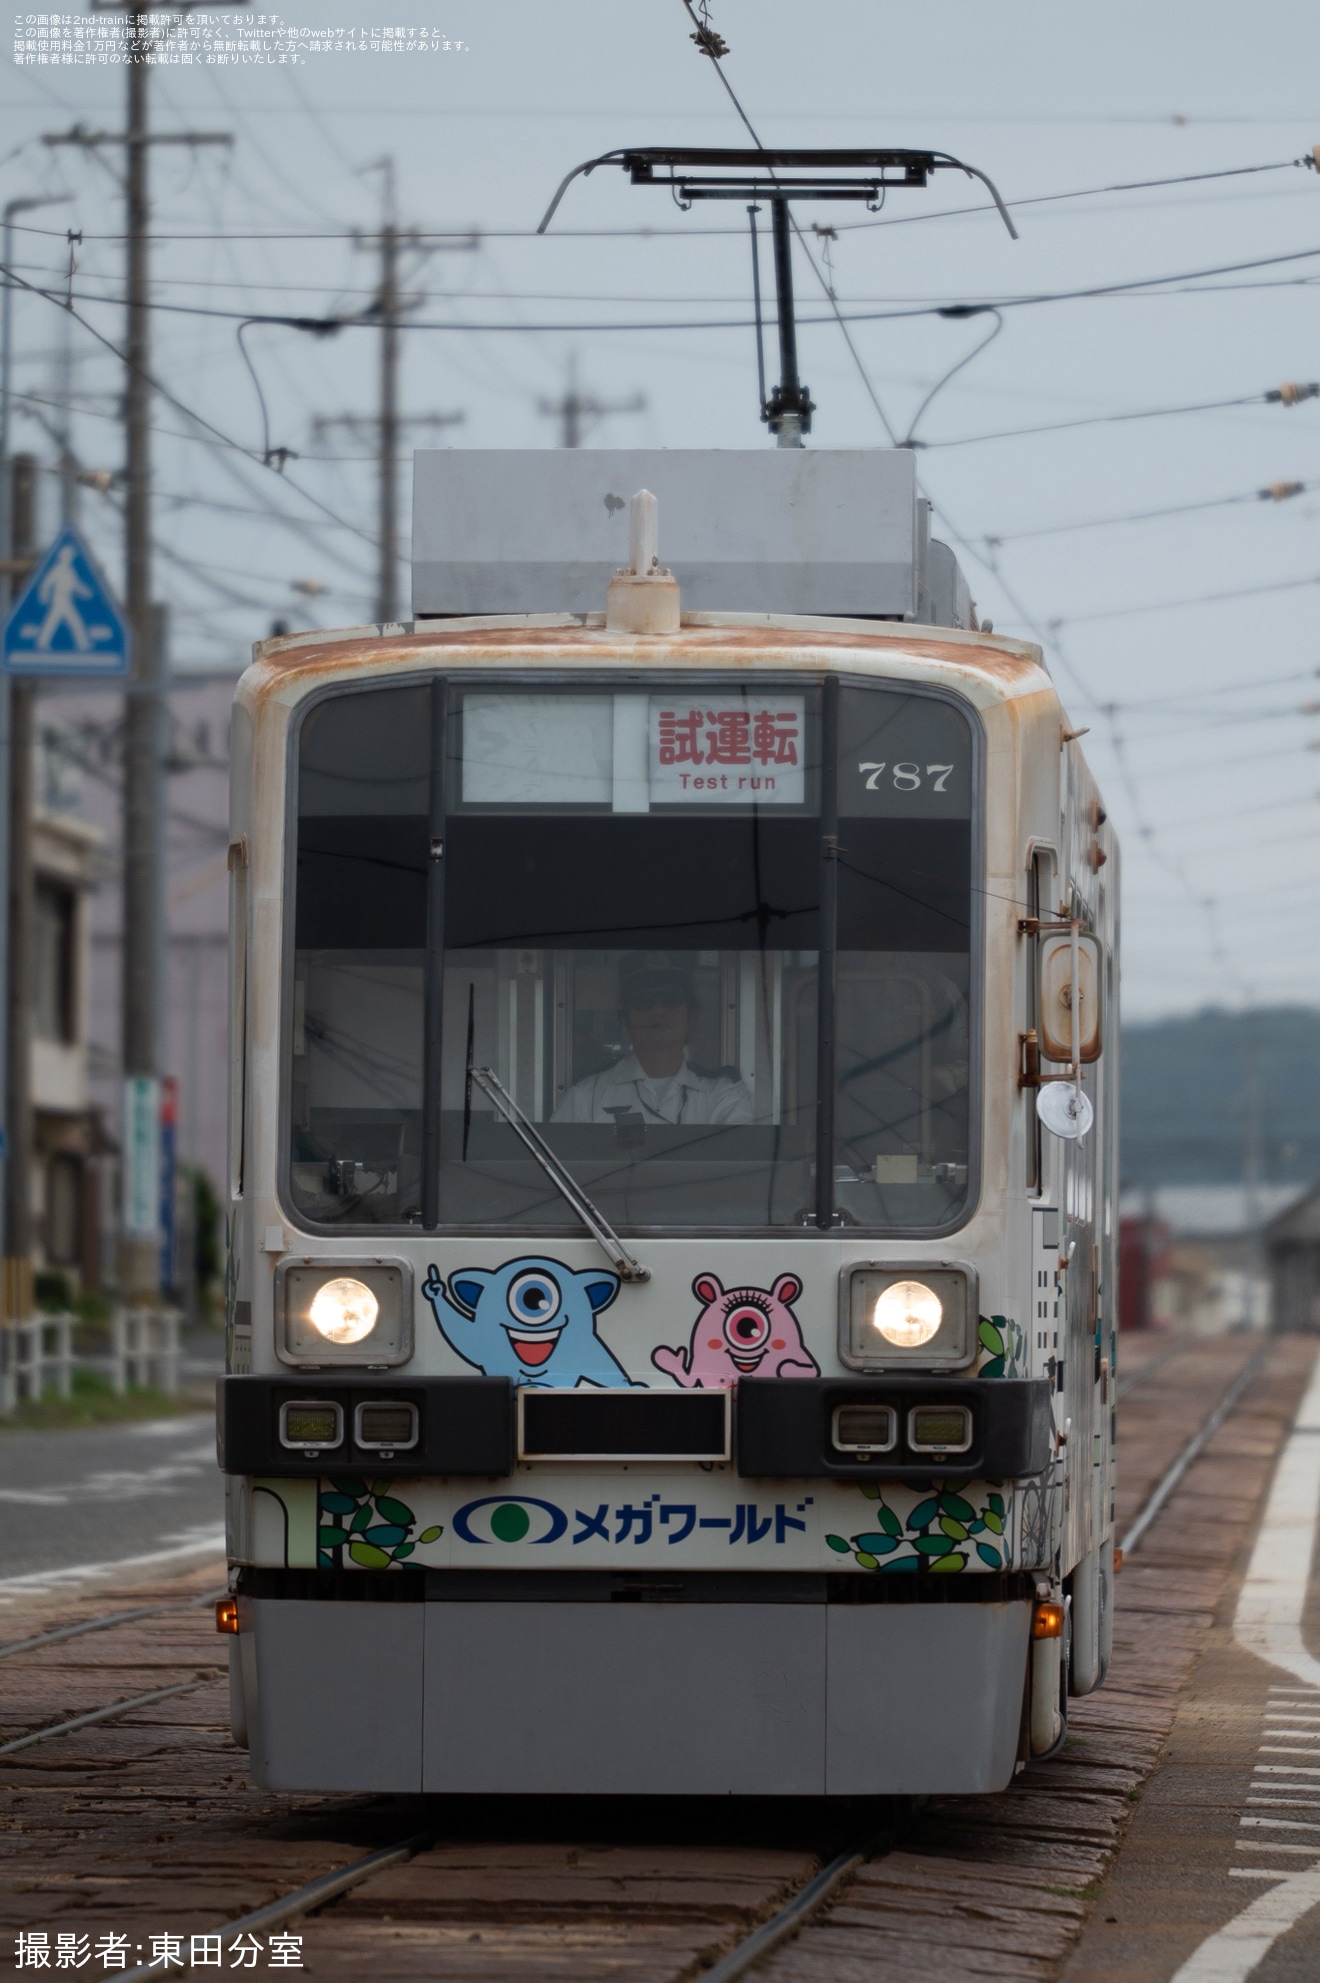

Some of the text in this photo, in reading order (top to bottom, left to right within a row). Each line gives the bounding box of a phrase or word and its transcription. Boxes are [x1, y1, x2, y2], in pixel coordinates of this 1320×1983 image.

[658, 710, 798, 766] 試運転
[679, 773, 776, 790] Test run
[858, 762, 954, 792] 787
[573, 1493, 814, 1545] メガワールド
